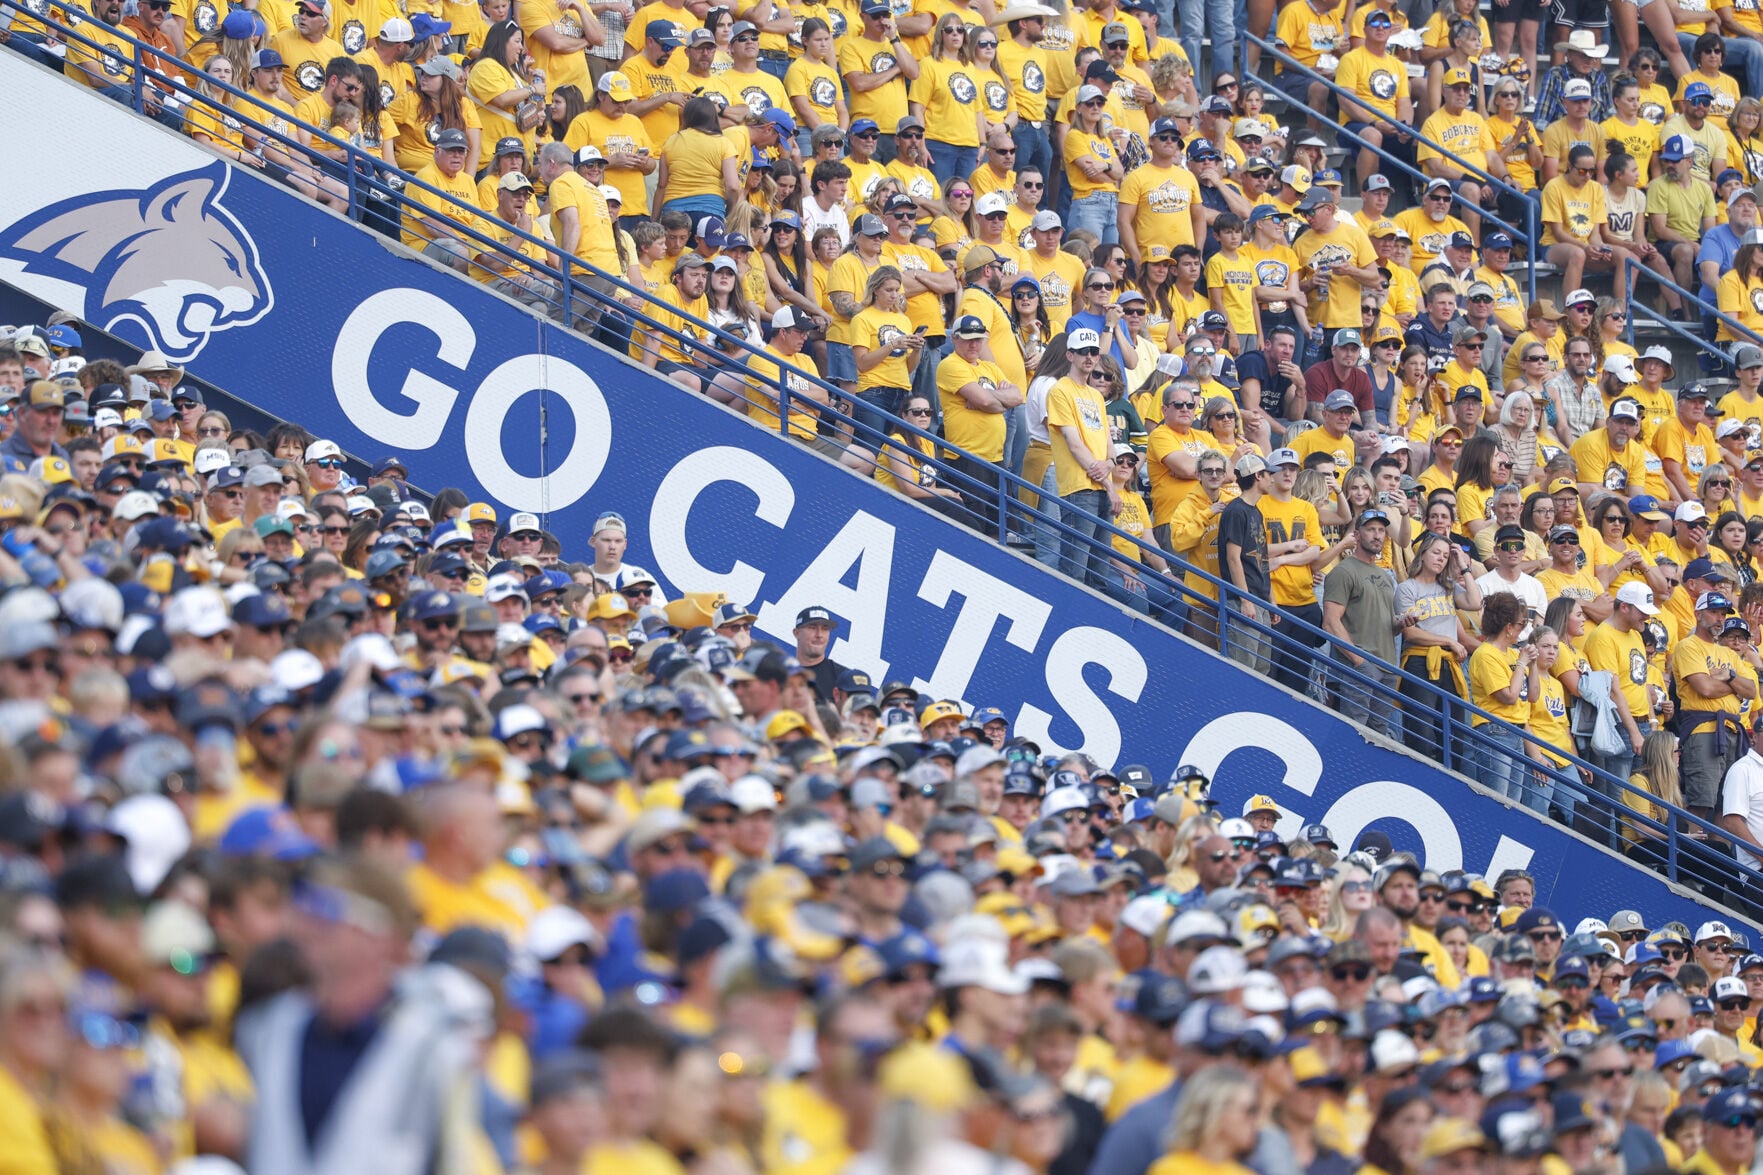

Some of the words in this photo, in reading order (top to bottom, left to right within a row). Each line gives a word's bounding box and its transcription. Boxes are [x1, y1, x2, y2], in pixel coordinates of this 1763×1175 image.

[1456, 71, 1466, 79] M
[1442, 125, 1479, 142] BOBCATS
[1622, 136, 1650, 149] ONTANA
[515, 174, 527, 183] M
[1148, 191, 1168, 206] GOLD
[1168, 190, 1190, 203] RUSH
[1608, 212, 1632, 232] M
[1079, 332, 1097, 342] CATS
[331, 287, 612, 514] GO
[648, 445, 1148, 771] CATS
[1266, 520, 1306, 546] M
[1414, 595, 1457, 621] CATS
[1544, 695, 1565, 713] Cats
